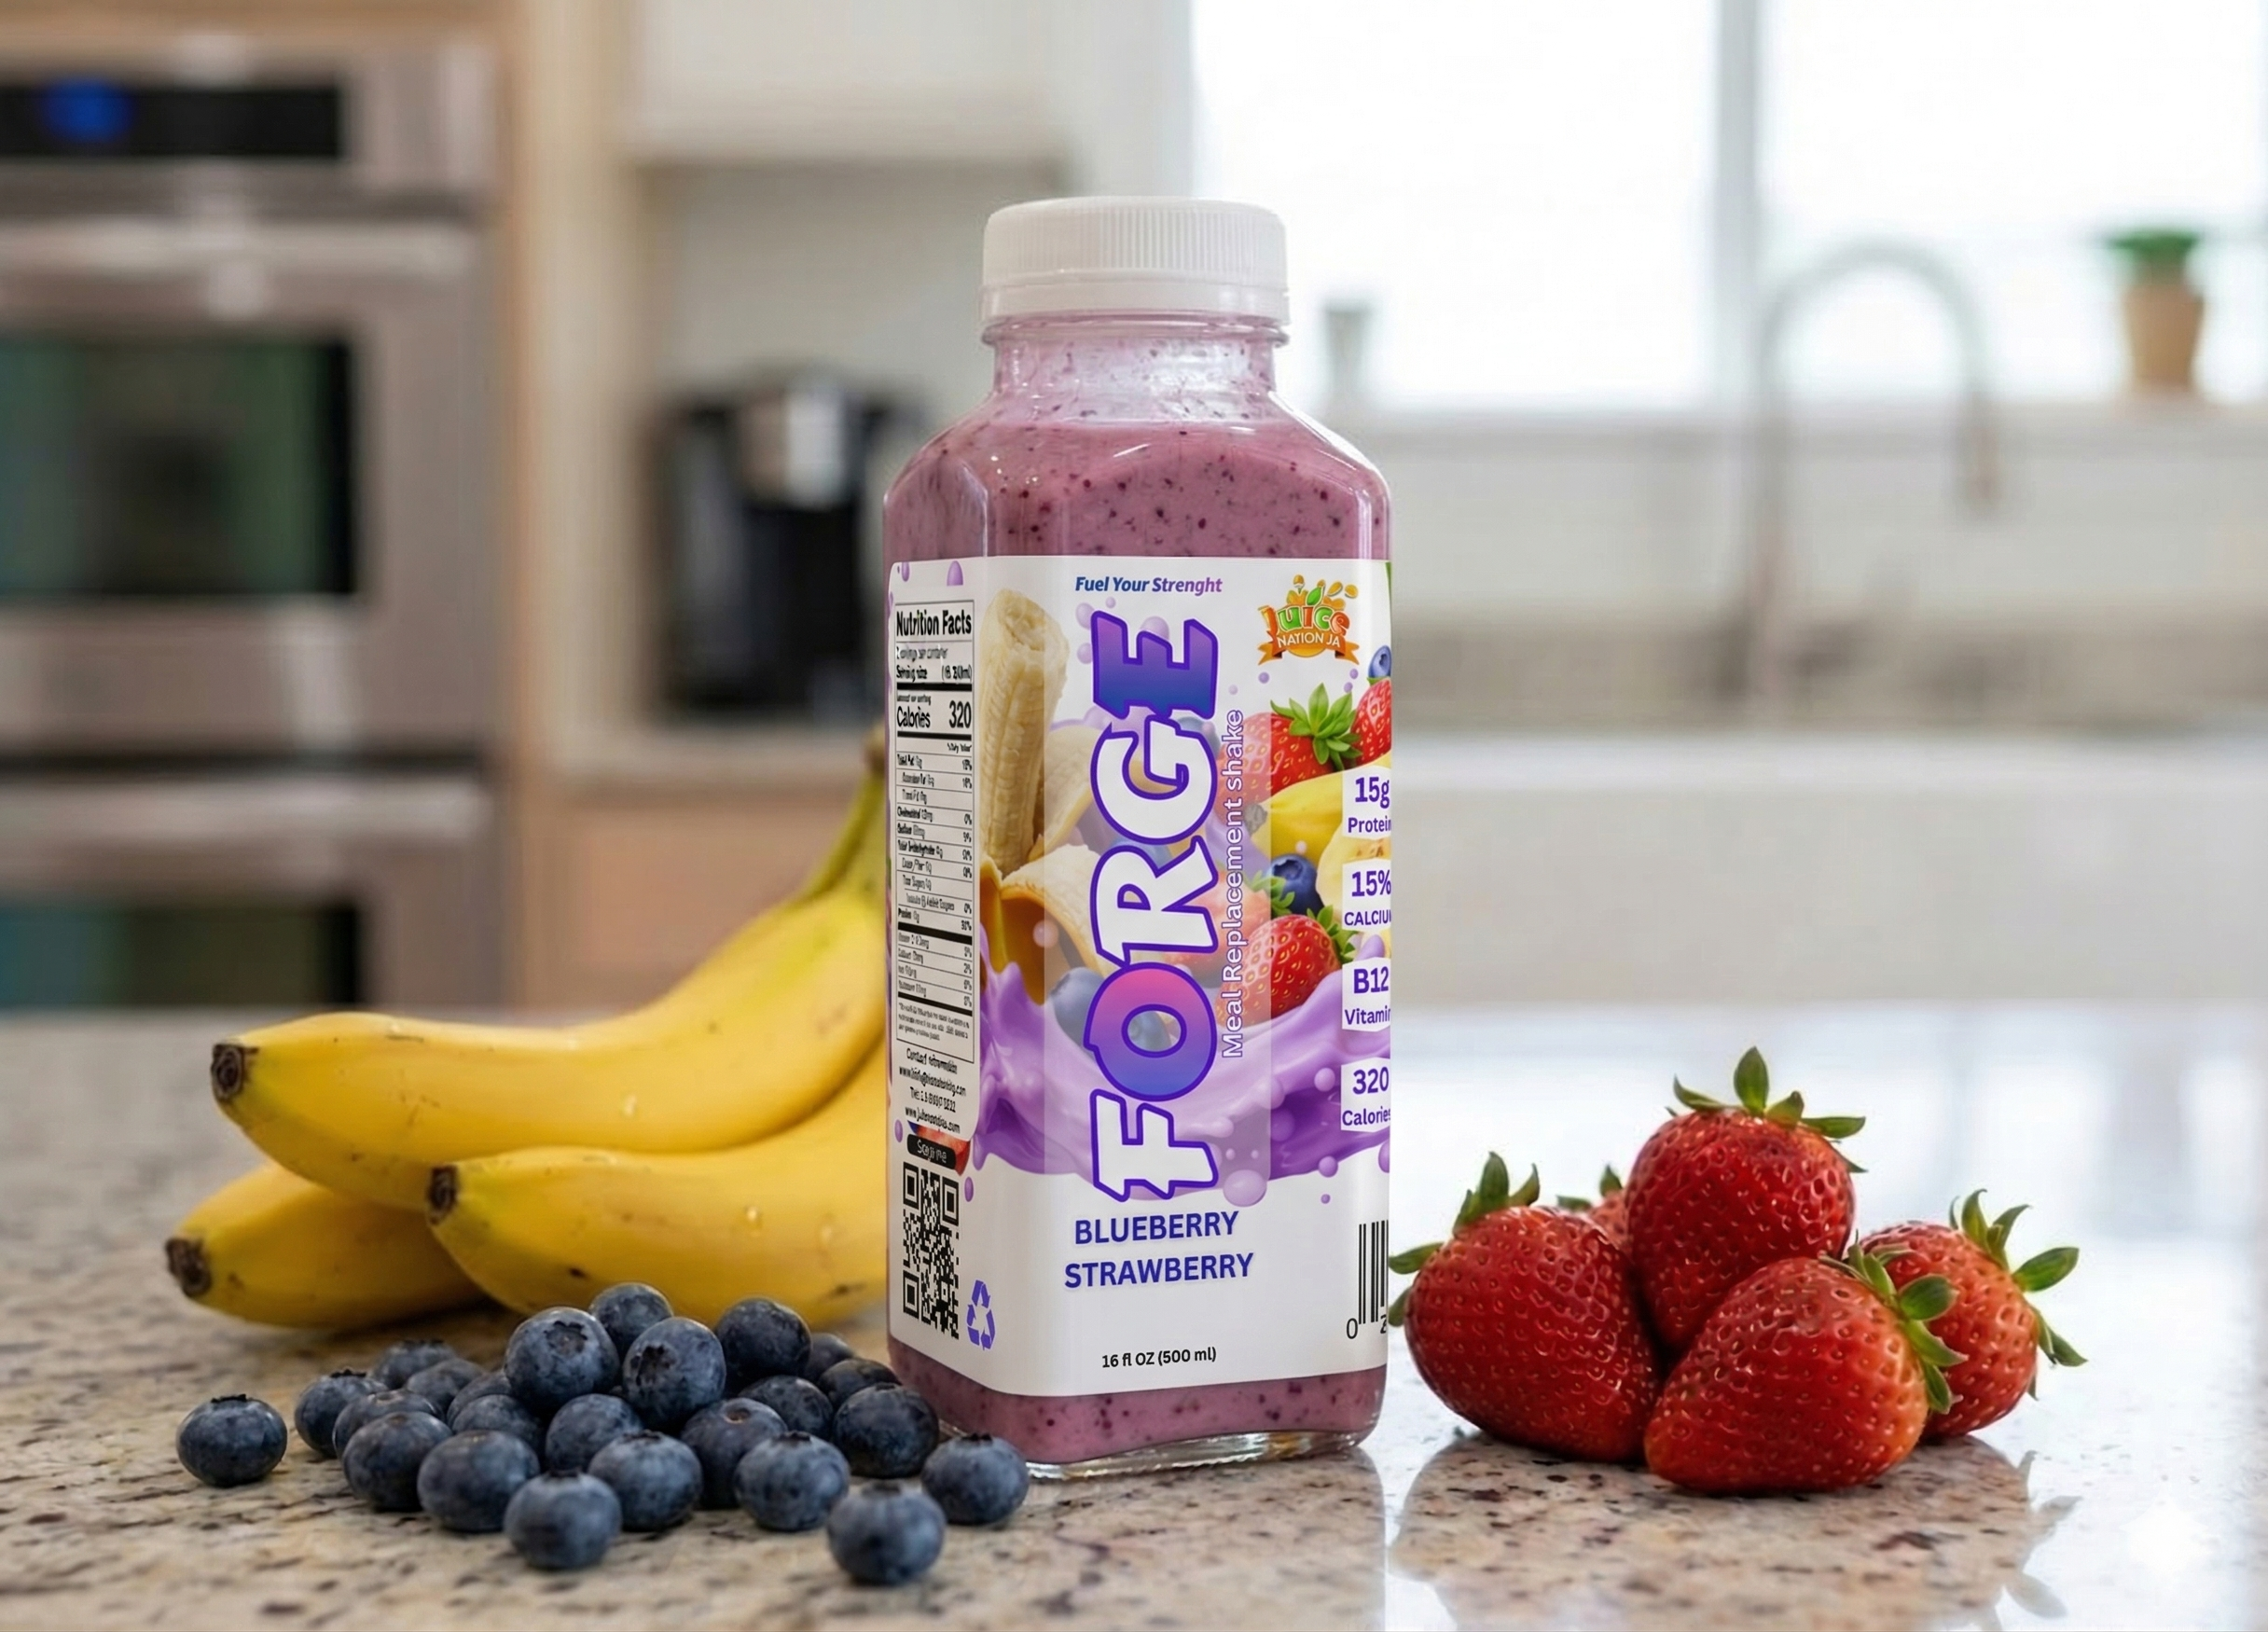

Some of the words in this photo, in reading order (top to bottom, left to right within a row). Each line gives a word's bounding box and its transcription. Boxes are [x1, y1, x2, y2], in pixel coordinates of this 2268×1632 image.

[1075, 576, 1109, 591] Fuel
[1113, 577, 1150, 591] Your
[1152, 577, 1223, 596] Strenght
[896, 609, 939, 637] Nutrition
[942, 609, 972, 635] Facts
[1278, 631, 1323, 648] NATION
[1326, 635, 1340, 647] JA
[949, 700, 972, 728] 320
[1222, 710, 1243, 791] shake
[1355, 776, 1390, 809] 15g
[1222, 797, 1248, 982] Replacement
[1351, 869, 1391, 897] 15%
[1084, 611, 1218, 1202] FORGE
[1344, 909, 1391, 926] CALCIU
[1353, 966, 1389, 994] B12
[1222, 989, 1243, 1058] Meal
[1352, 1066, 1390, 1094] 320
[1075, 1210, 1239, 1245] BLUEBERRY
[1064, 1252, 1253, 1289] STRAWBERRY
[1346, 1318, 1358, 1339] 0
[1102, 1354, 1119, 1368] 16
[1122, 1353, 1132, 1366] fl
[1135, 1352, 1155, 1365] OZ
[1157, 1349, 1190, 1366] (500
[1194, 1347, 1217, 1362] ml)
